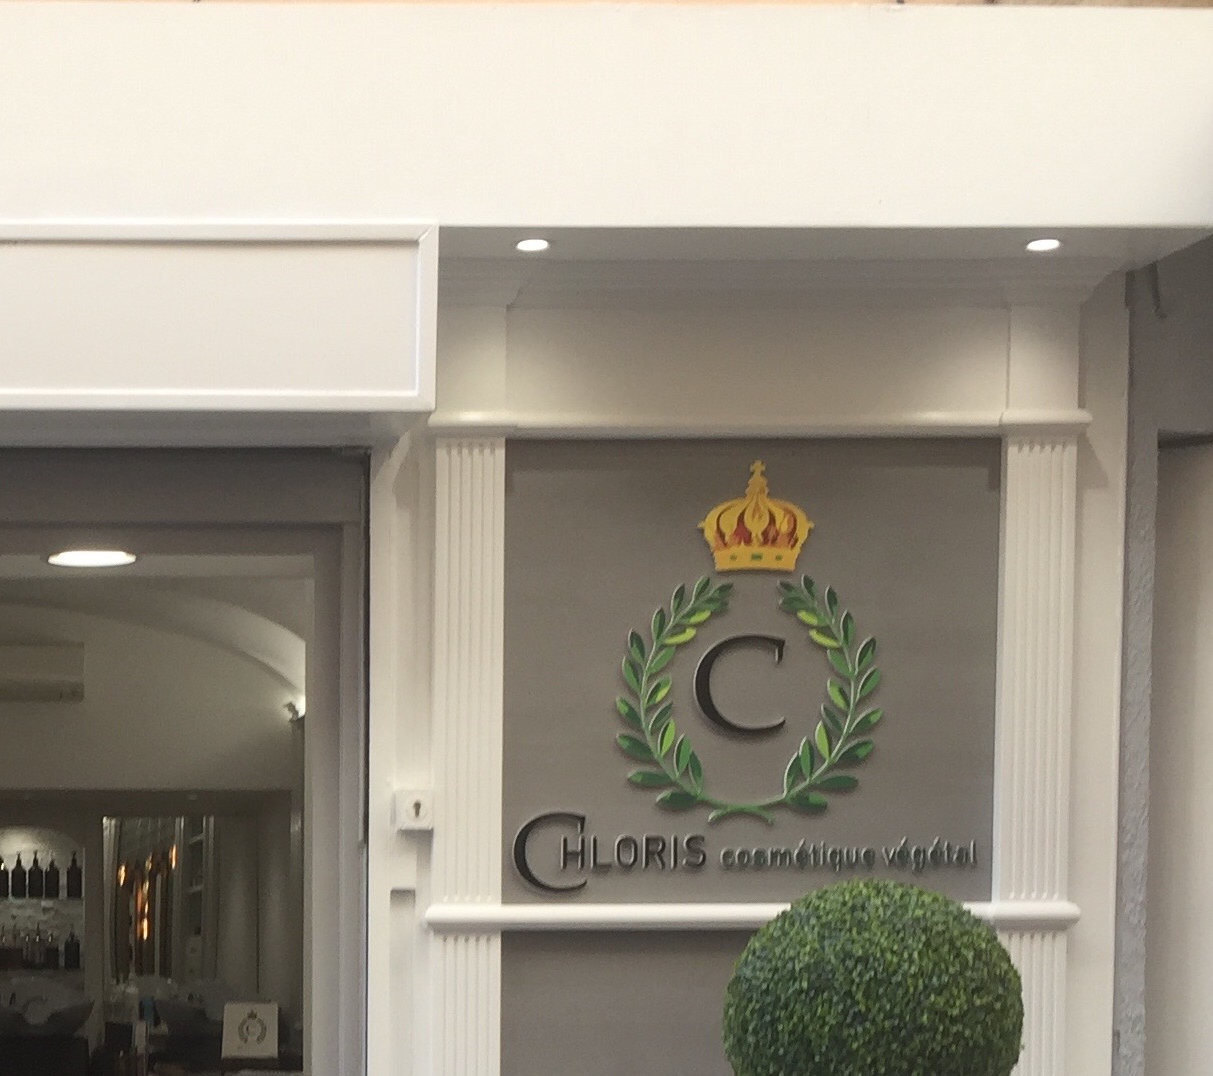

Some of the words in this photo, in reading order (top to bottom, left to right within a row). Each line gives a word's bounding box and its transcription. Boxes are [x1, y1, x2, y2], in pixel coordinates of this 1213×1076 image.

[693, 634, 786, 735] C
[512, 810, 706, 892] CHLORIS
[720, 838, 876, 873] cosmétique
[882, 836, 978, 874] végétal
